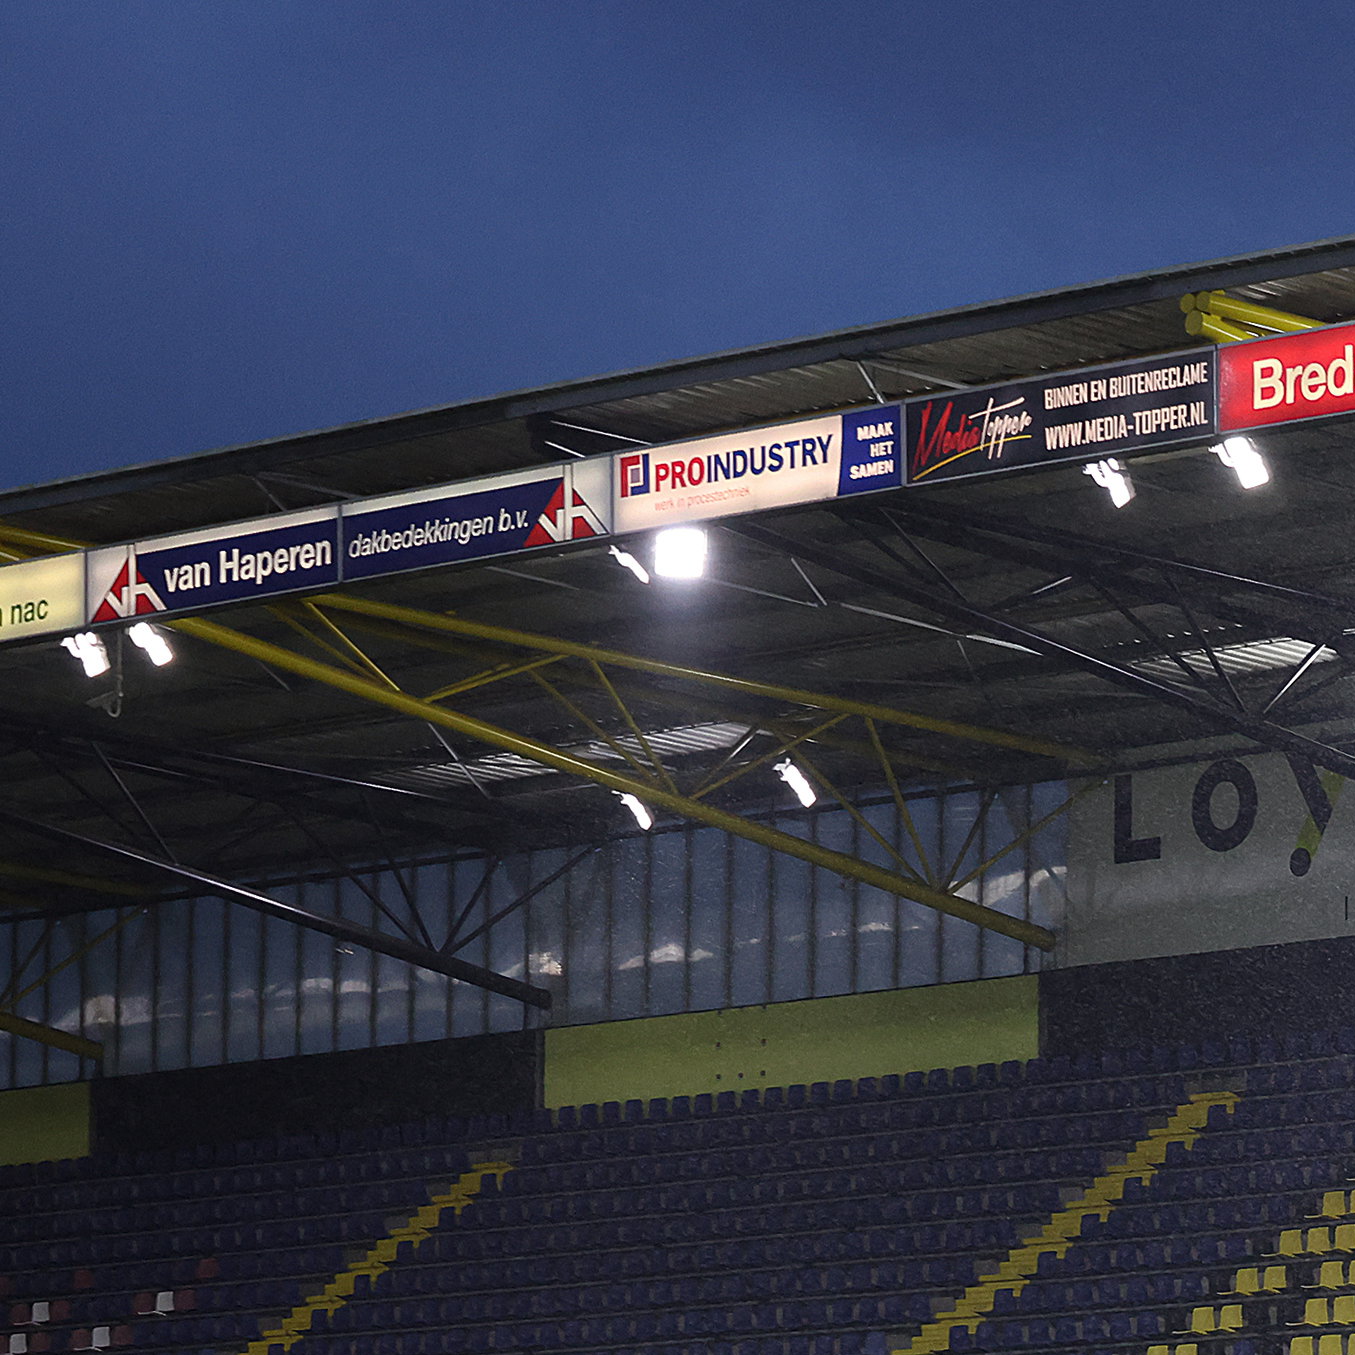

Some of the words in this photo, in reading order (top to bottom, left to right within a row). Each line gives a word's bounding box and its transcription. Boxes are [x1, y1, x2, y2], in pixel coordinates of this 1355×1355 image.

[1044, 381, 1088, 409] BINNEN
[1091, 379, 1106, 400] EN
[1110, 362, 1208, 398] BUITENRECLAME
[857, 421, 893, 441] MAAK
[1045, 401, 1208, 450] WWW.MEDIA-TOPPER.NL
[654, 434, 834, 492] PROINDUSTRY
[850, 460, 894, 480] SAMEN
[870, 441, 893, 458] HET
[348, 513, 493, 558] dakbedekkingen
[498, 508, 529, 532] b.v.
[164, 561, 211, 592] van
[219, 539, 332, 584] Haperen
[10, 599, 49, 624] nac
